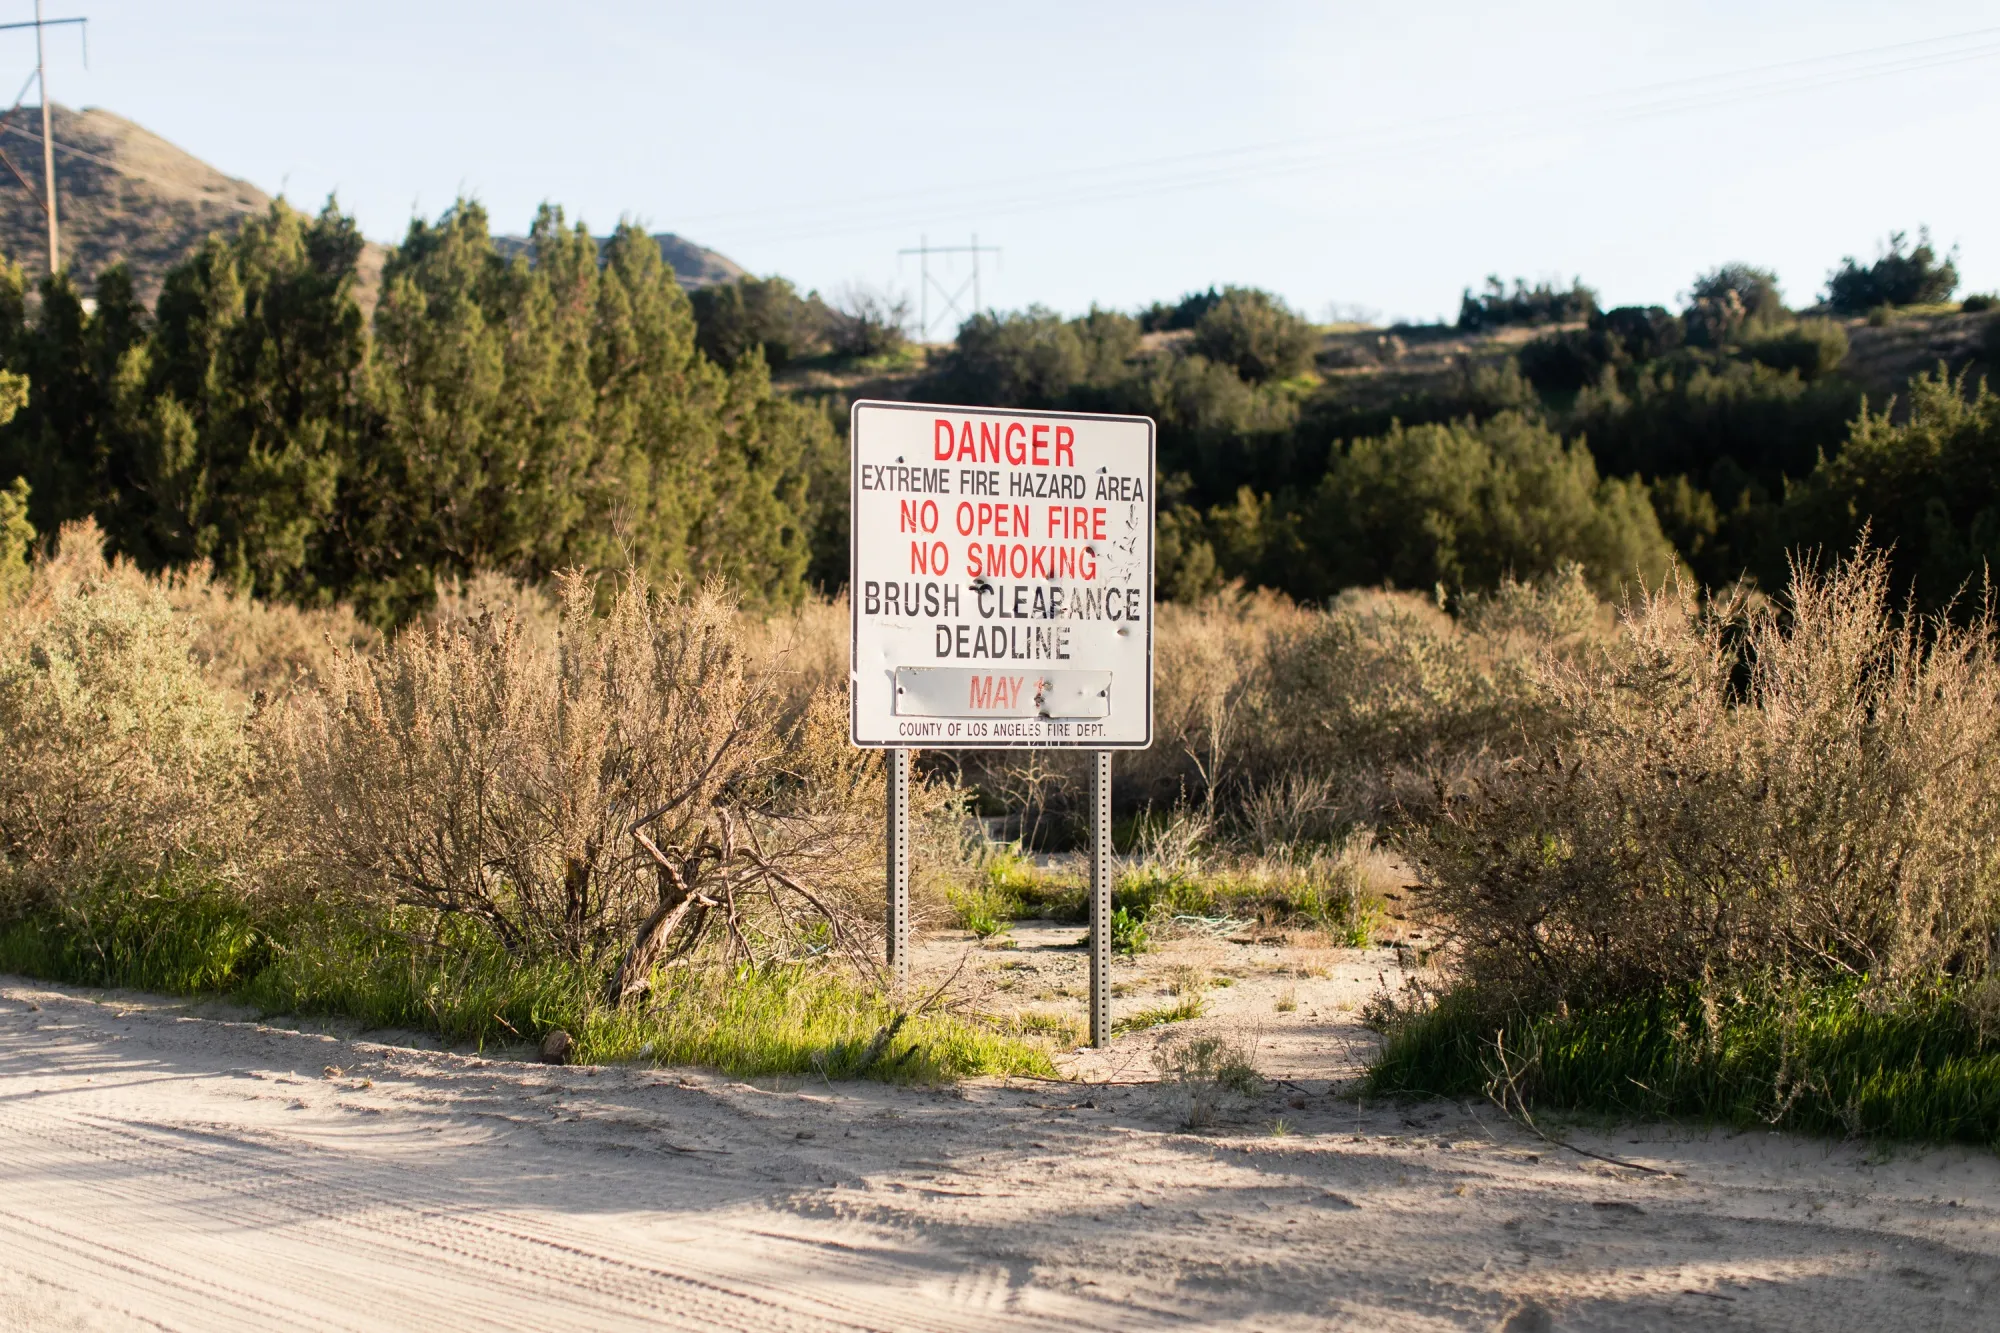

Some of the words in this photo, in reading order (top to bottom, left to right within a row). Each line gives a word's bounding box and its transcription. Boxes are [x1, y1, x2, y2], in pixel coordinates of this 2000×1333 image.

[934, 419, 1074, 467] DANGER
[861, 464, 950, 494] EXTREME
[960, 469, 1000, 496] FIRE
[1009, 471, 1086, 500] HAZARD
[1095, 476, 1145, 502] AREA
[900, 499, 939, 534] NO
[956, 501, 1030, 538] OPEN
[1048, 505, 1107, 541] FIRE
[911, 541, 949, 576] NO
[966, 542, 1097, 580] SMOKING
[864, 580, 960, 617] BRUSH
[977, 583, 1140, 622] CLEARANCE
[936, 624, 1071, 660] DEADLINE
[969, 675, 1024, 709] MAY
[899, 722, 942, 737] COUNTY
[947, 722, 962, 737] OF
[967, 722, 988, 737] LOS
[993, 723, 1041, 737] ANGELES
[1047, 723, 1071, 737] FIRE
[1076, 723, 1106, 737] DEPT.
